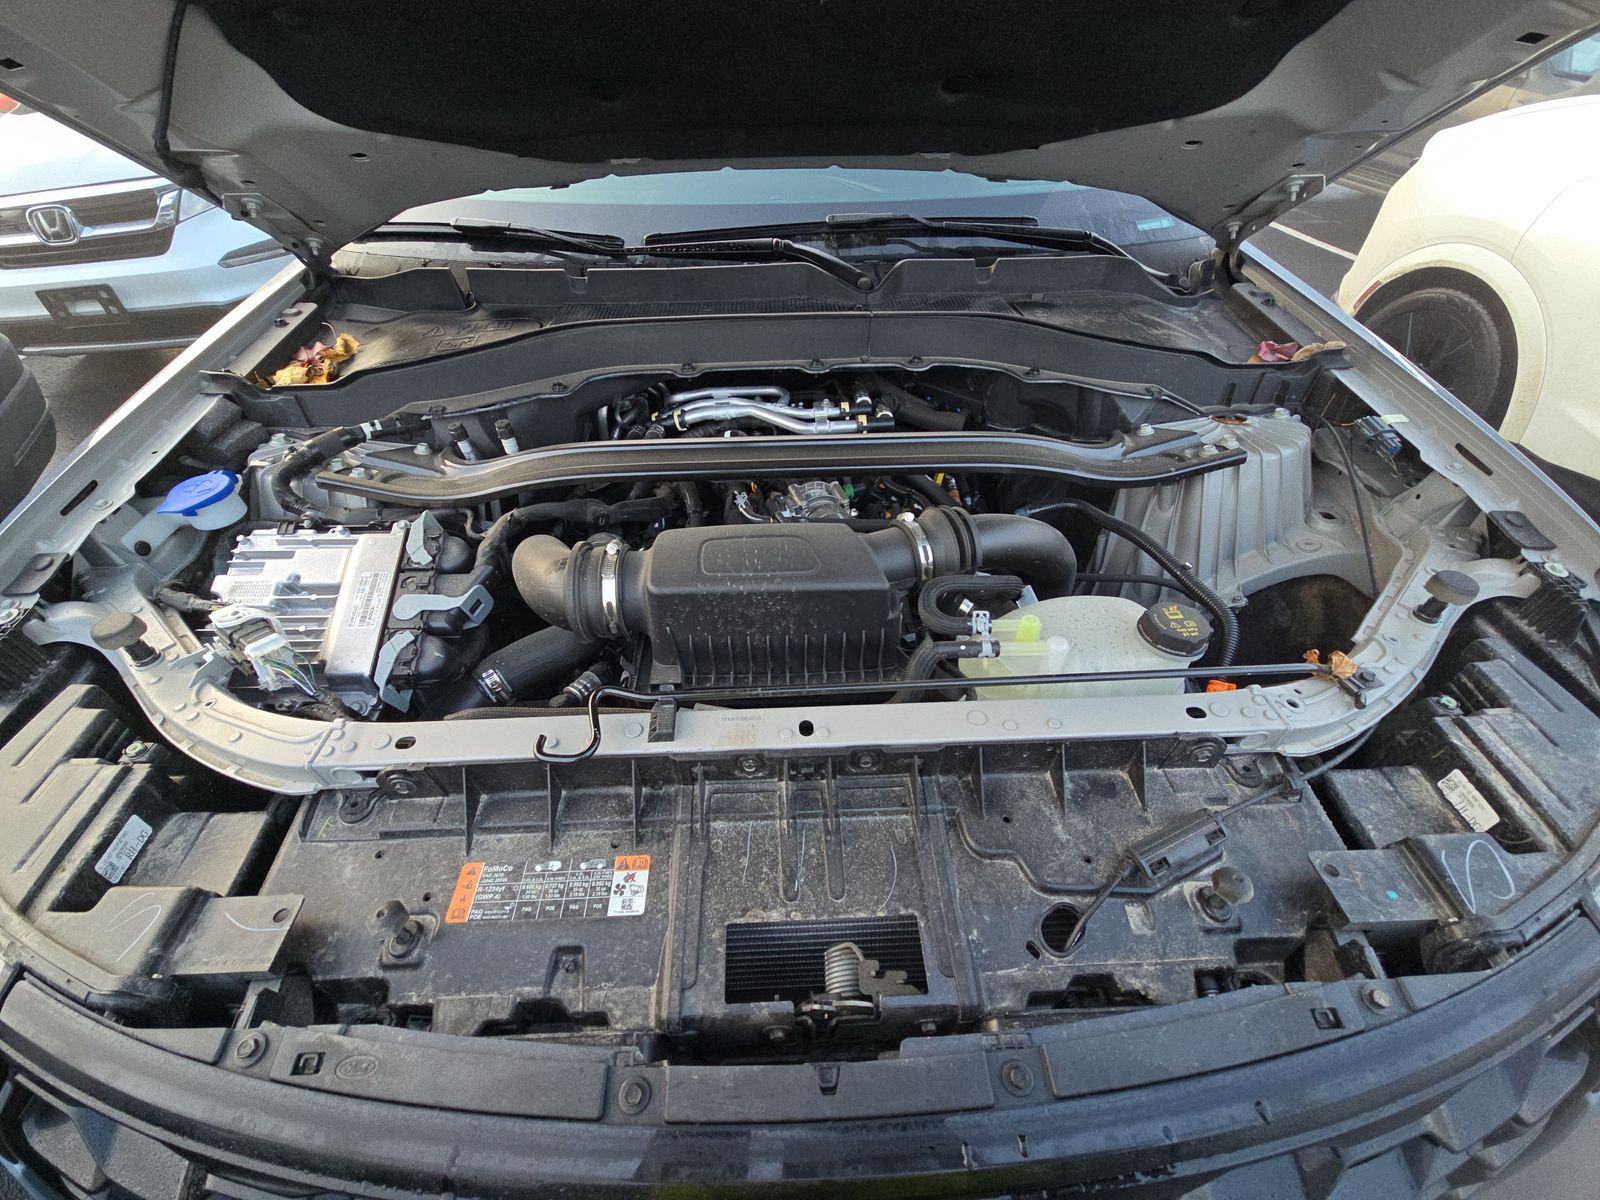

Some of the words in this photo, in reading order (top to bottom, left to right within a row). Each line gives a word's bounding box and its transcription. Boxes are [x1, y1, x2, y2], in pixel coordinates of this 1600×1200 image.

[125, 829, 149, 860] RH-DG
[483, 864, 514, 872] FoMoCo
[477, 885, 506, 893] R-1234yf
